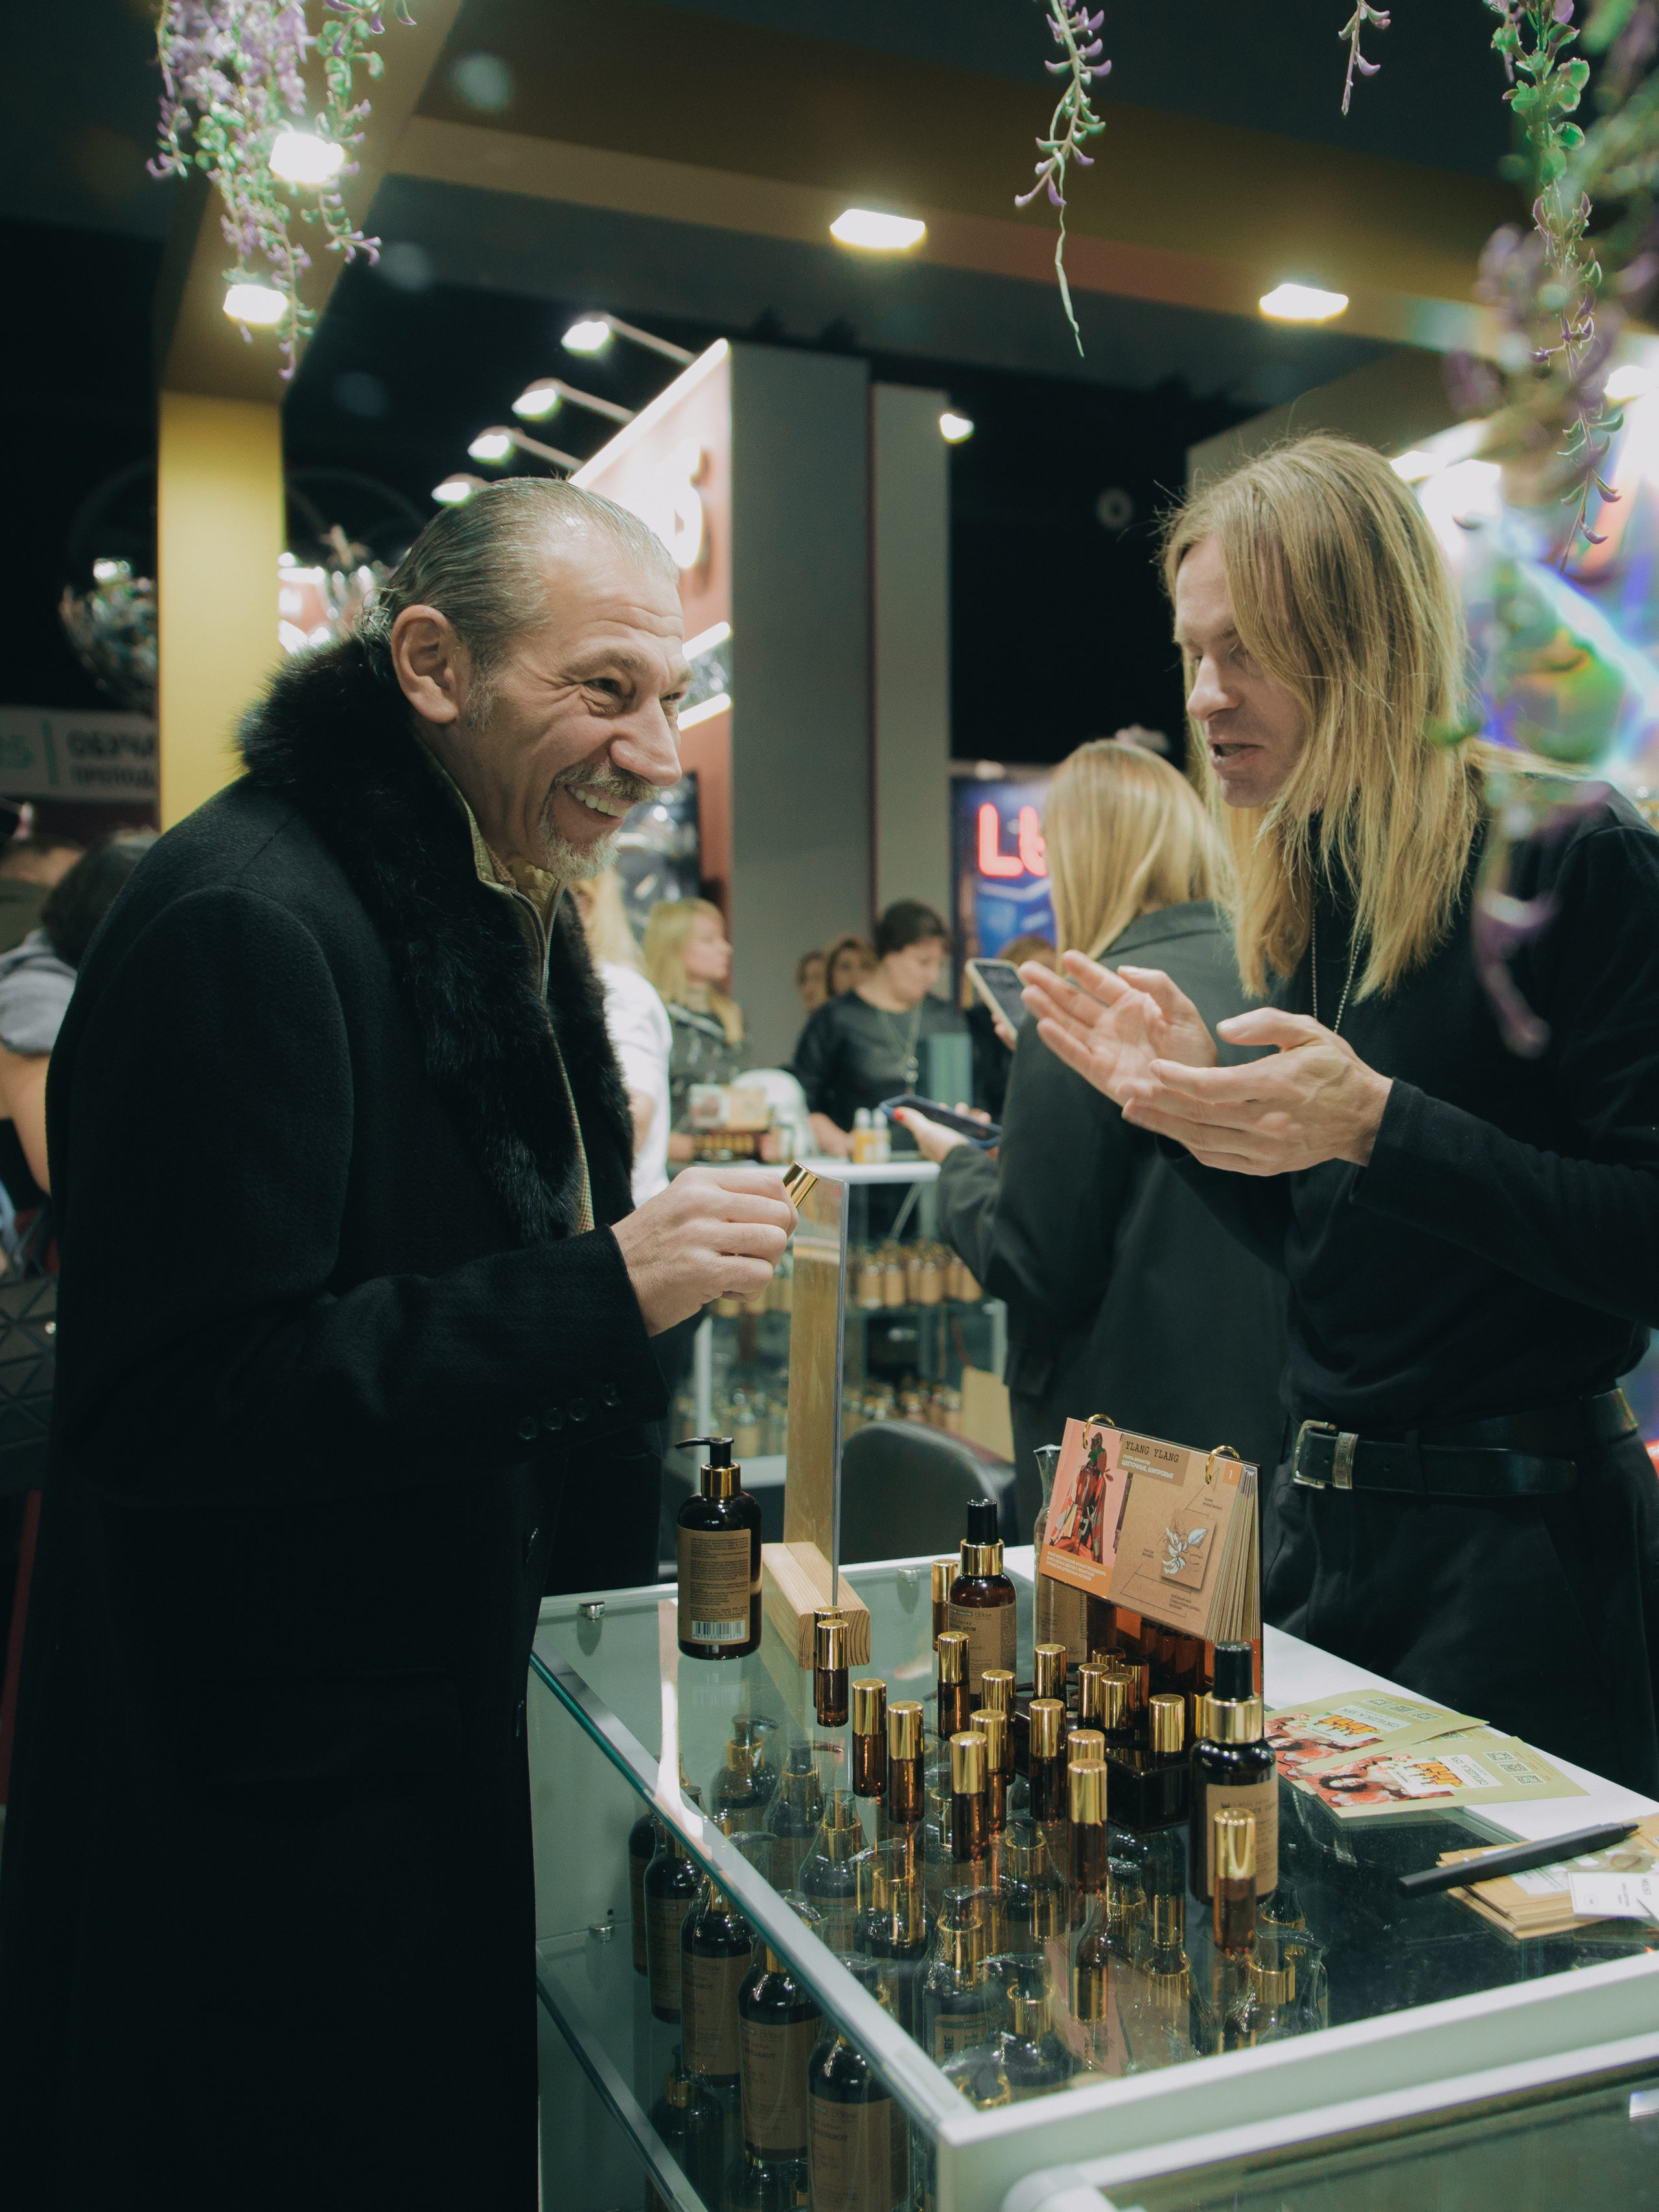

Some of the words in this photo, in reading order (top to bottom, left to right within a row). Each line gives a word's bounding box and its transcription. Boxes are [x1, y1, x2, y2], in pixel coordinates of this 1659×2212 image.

[1126, 1441, 1150, 1454] YLANG
[1154, 1449, 1179, 1463] YLANG
[1148, 1467, 1174, 1479] ШИПРОВЫЕ
[1229, 1469, 1233, 1480] 1
